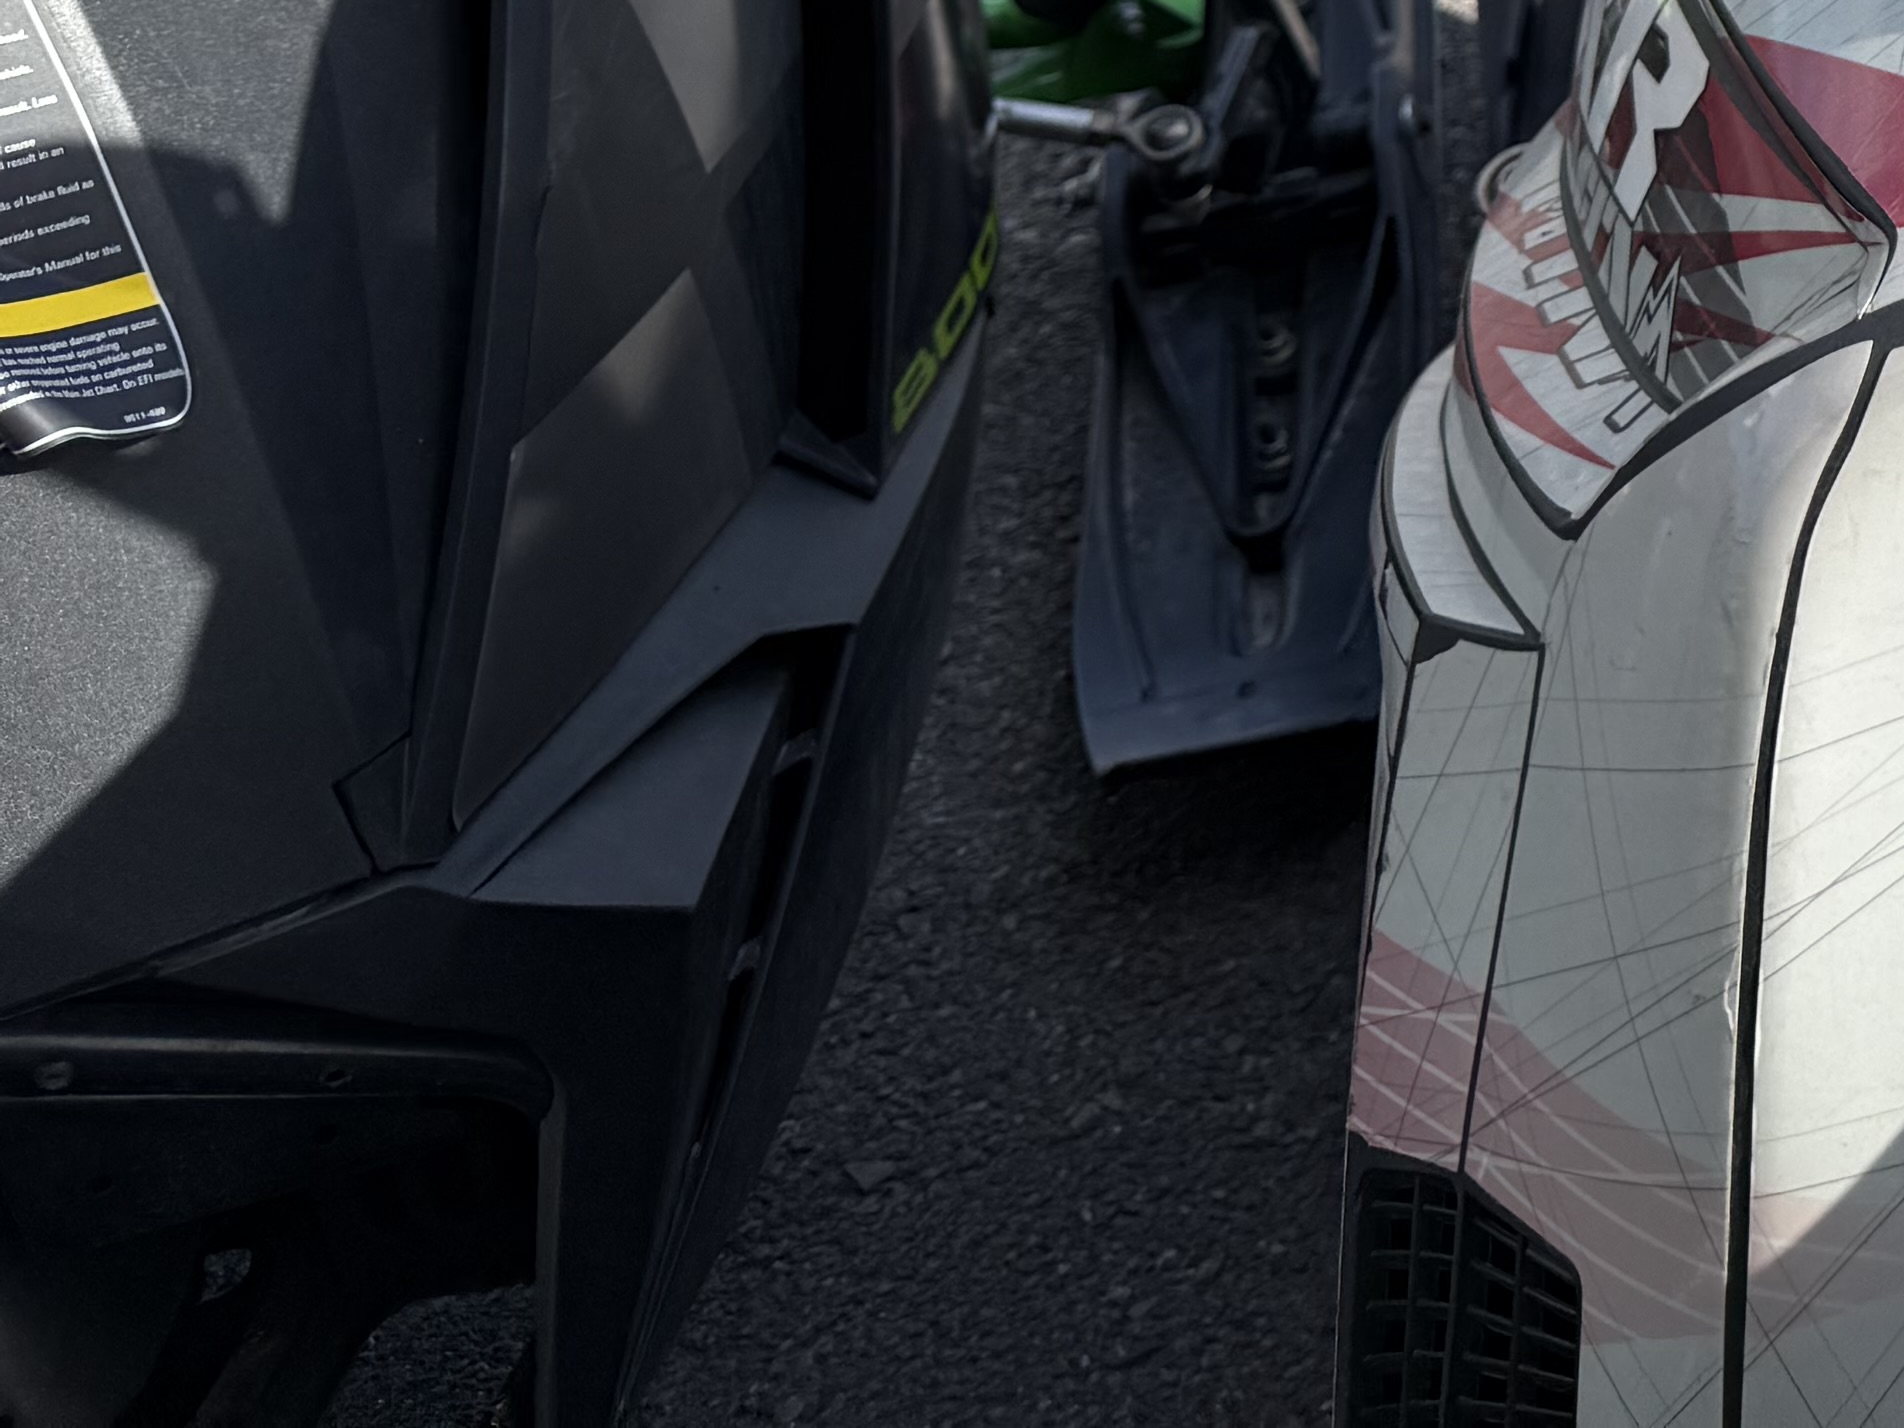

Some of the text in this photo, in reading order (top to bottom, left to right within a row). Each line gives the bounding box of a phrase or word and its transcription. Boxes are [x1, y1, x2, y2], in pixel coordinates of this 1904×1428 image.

[7, 153, 37, 169] result
[51, 147, 65, 158] an
[14, 195, 24, 209] of
[26, 189, 56, 205] brake
[57, 181, 80, 196] fluid
[82, 179, 95, 190] as
[37, 214, 91, 236] exceeding
[44, 253, 84, 273] Manual
[85, 250, 100, 261] for
[101, 244, 122, 256] this
[40, 340, 68, 352] engine
[69, 331, 107, 348] damage
[107, 325, 129, 338] may
[76, 342, 121, 359] operating
[97, 351, 131, 367] vehicle
